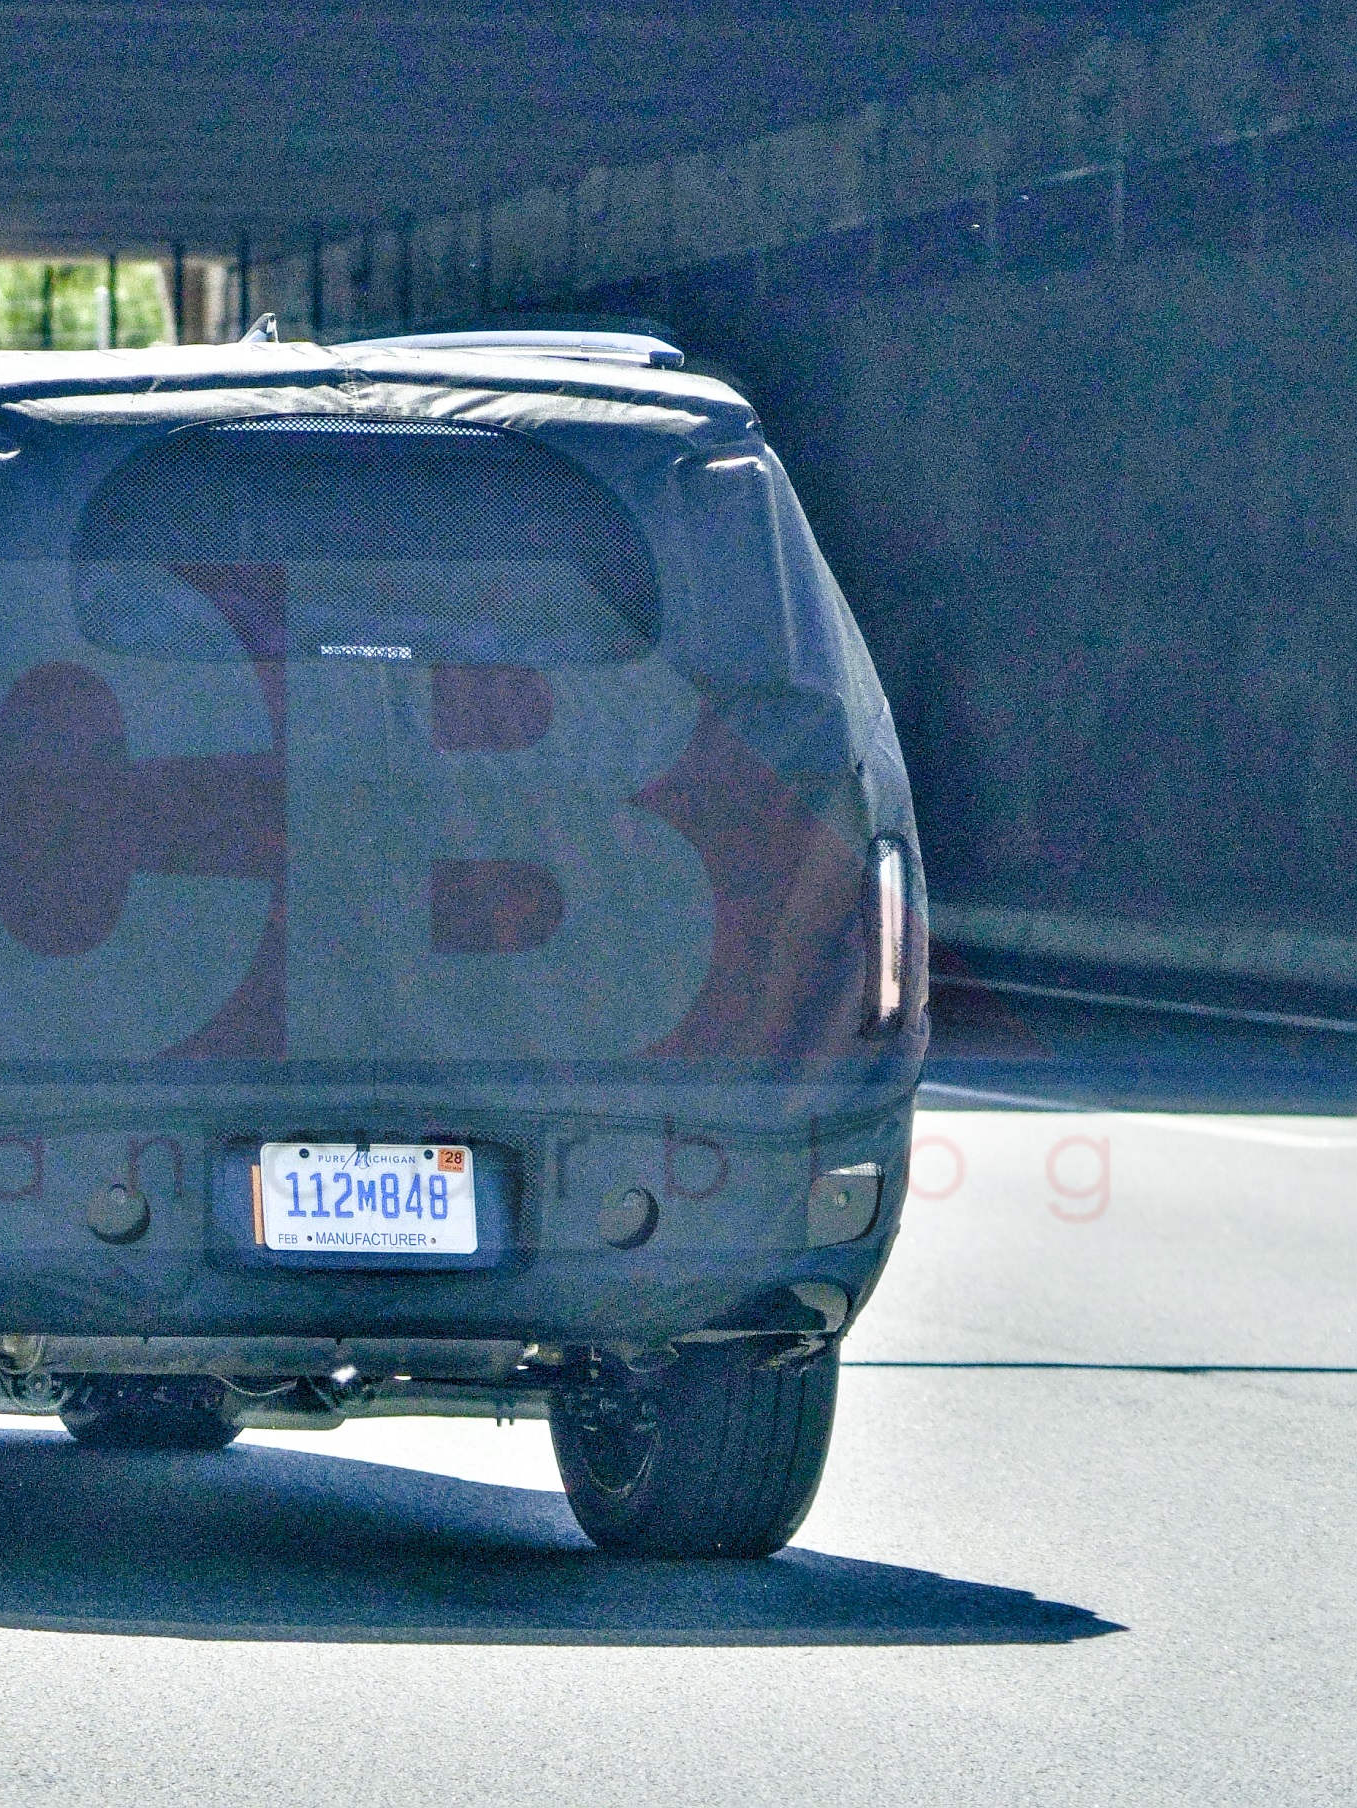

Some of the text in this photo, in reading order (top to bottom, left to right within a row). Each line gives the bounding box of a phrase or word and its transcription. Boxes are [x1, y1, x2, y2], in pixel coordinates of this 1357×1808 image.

[318, 1150, 417, 1170] PURE MICHIGAN
[444, 1151, 463, 1165] 28
[285, 1171, 449, 1220] 112M848
[278, 1233, 298, 1245] FEB
[315, 1231, 427, 1246] MANUFACTURER
